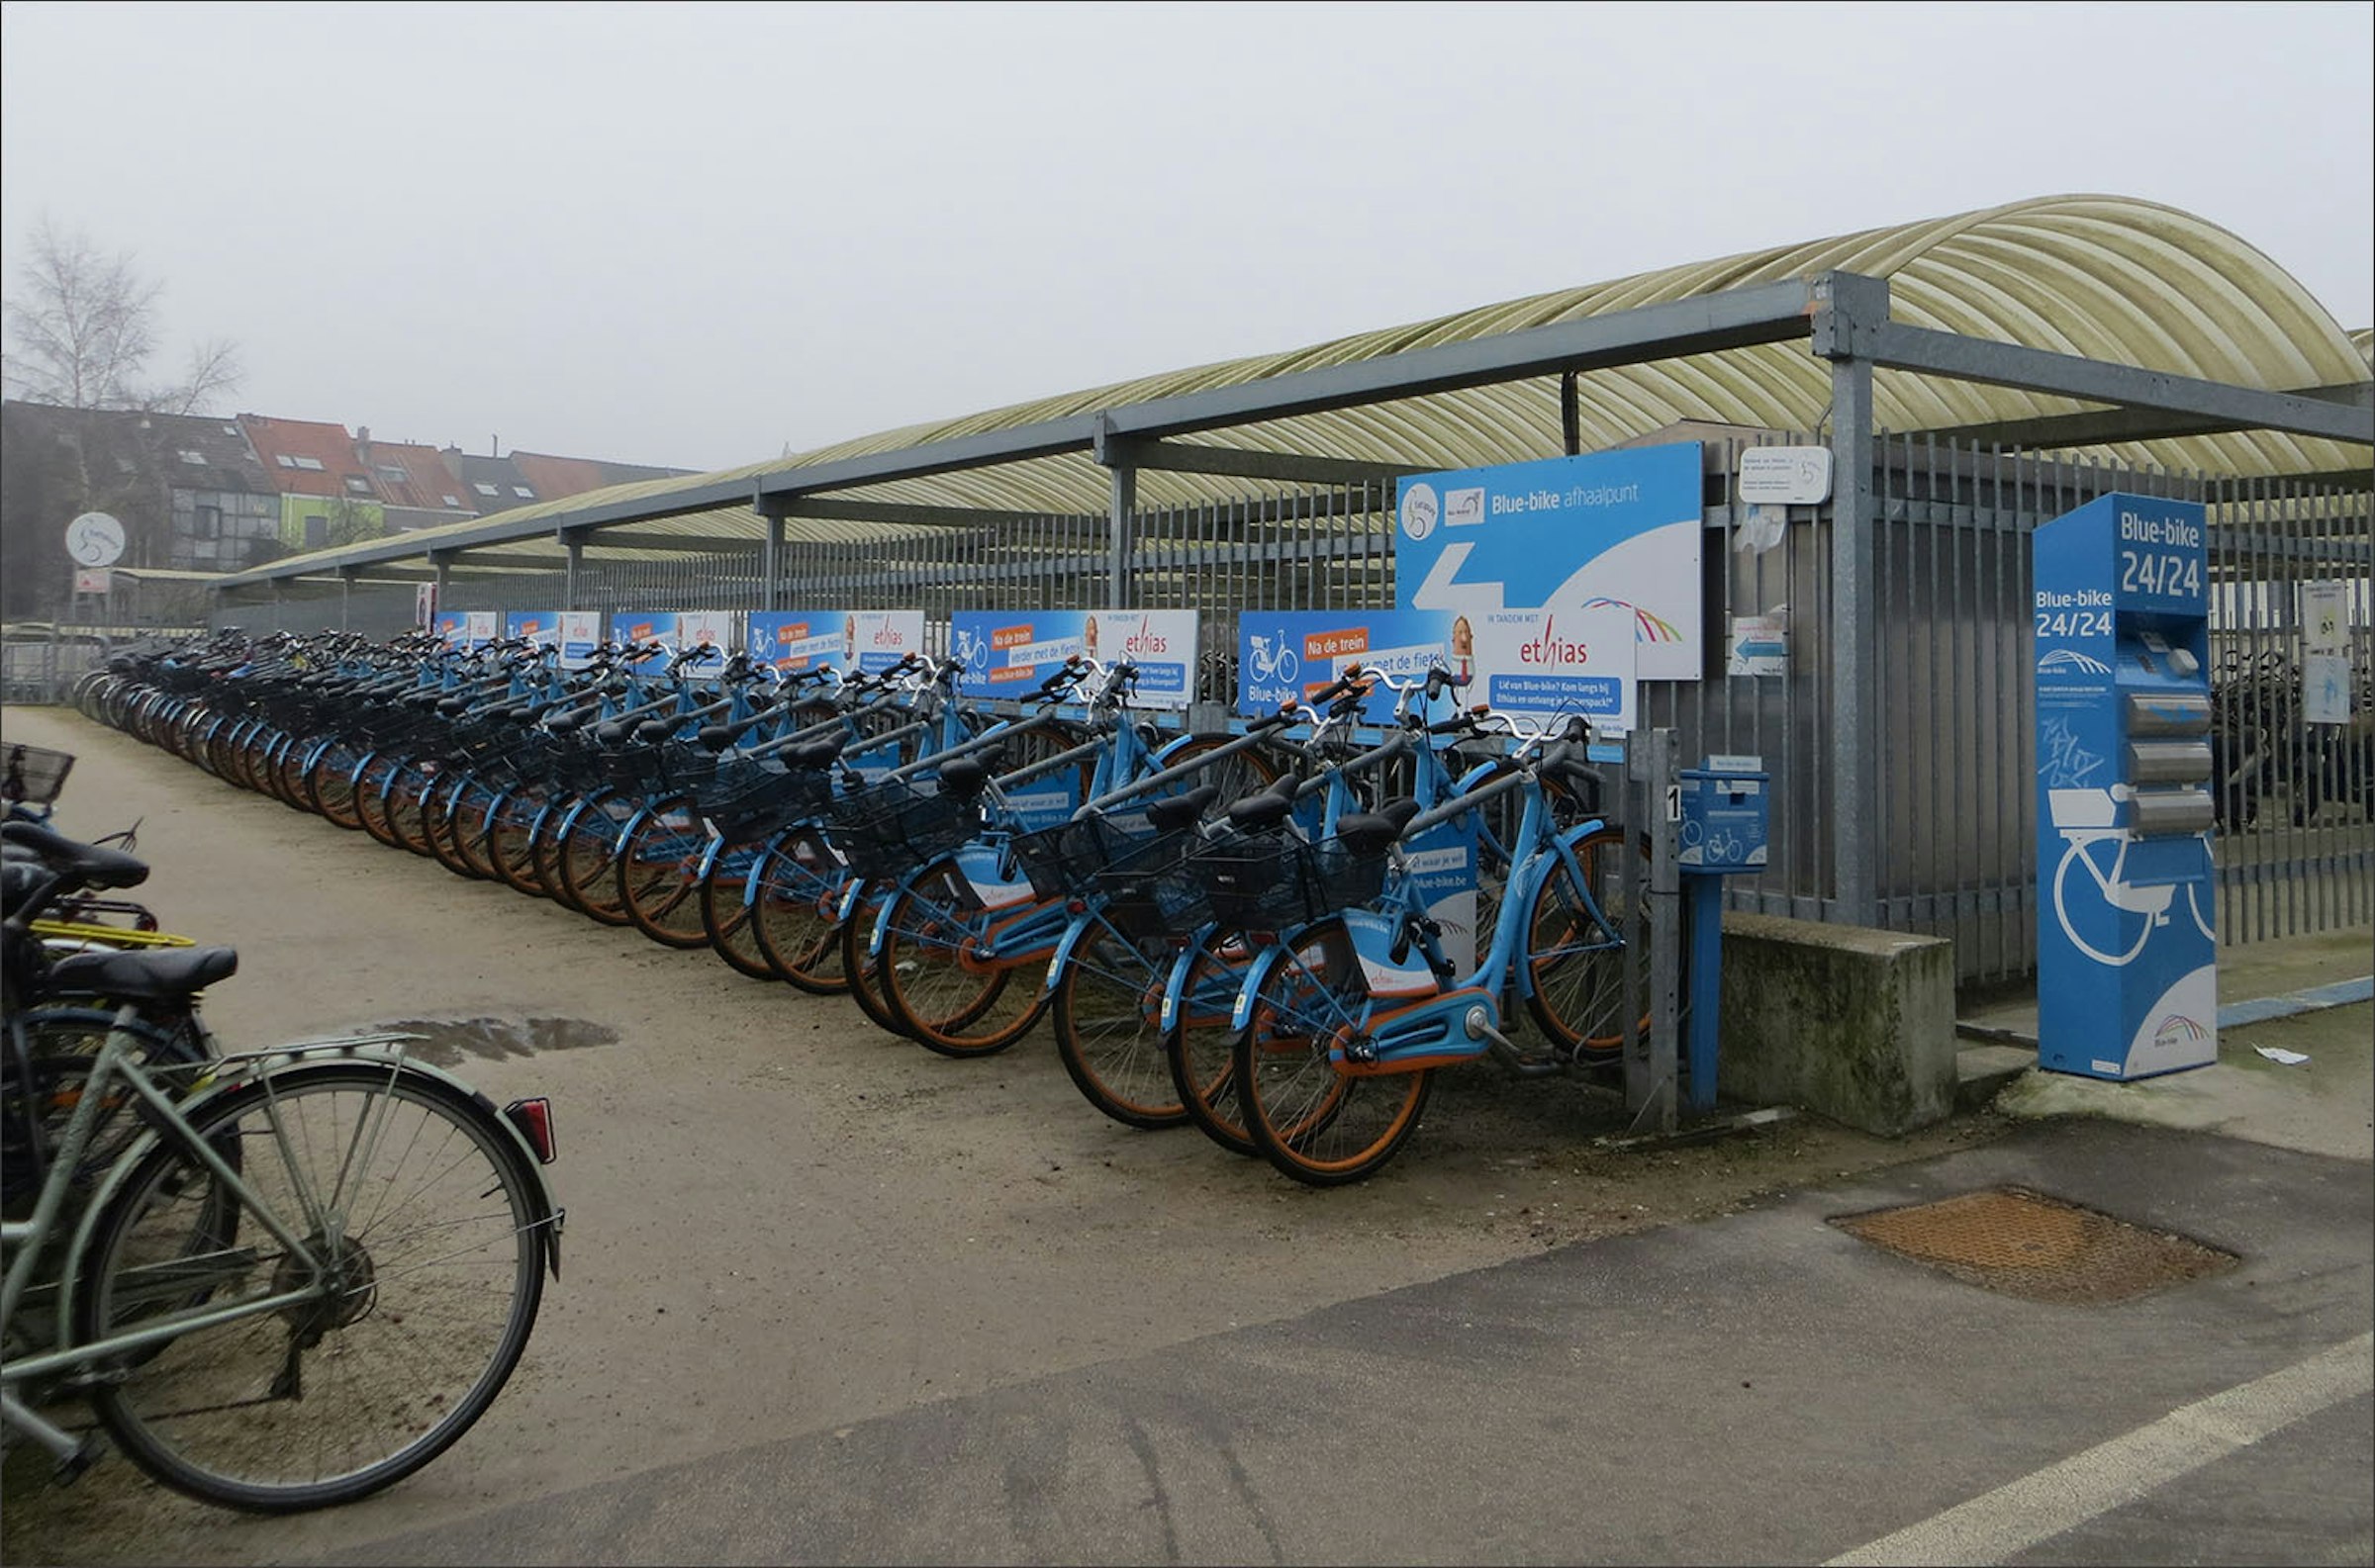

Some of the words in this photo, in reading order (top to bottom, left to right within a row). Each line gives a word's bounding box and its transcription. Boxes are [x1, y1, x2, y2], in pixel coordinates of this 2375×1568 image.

[1492, 491, 1561, 514] Blue-bike
[1564, 484, 1639, 507] afhaalpunt
[2122, 511, 2200, 548] Blue-bike
[2122, 551, 2201, 599] 24/24
[2036, 589, 2113, 608] Blue-bike
[1126, 614, 1167, 660] ethias
[2036, 611, 2113, 638] 24/24
[1308, 640, 1321, 655] Na
[1324, 638, 1337, 653] de
[1340, 634, 1365, 652] trein
[1520, 614, 1587, 673] ethias
[1396, 654, 1411, 670] de
[1248, 684, 1298, 703] Blue-bike
[1668, 786, 1678, 820] 1
